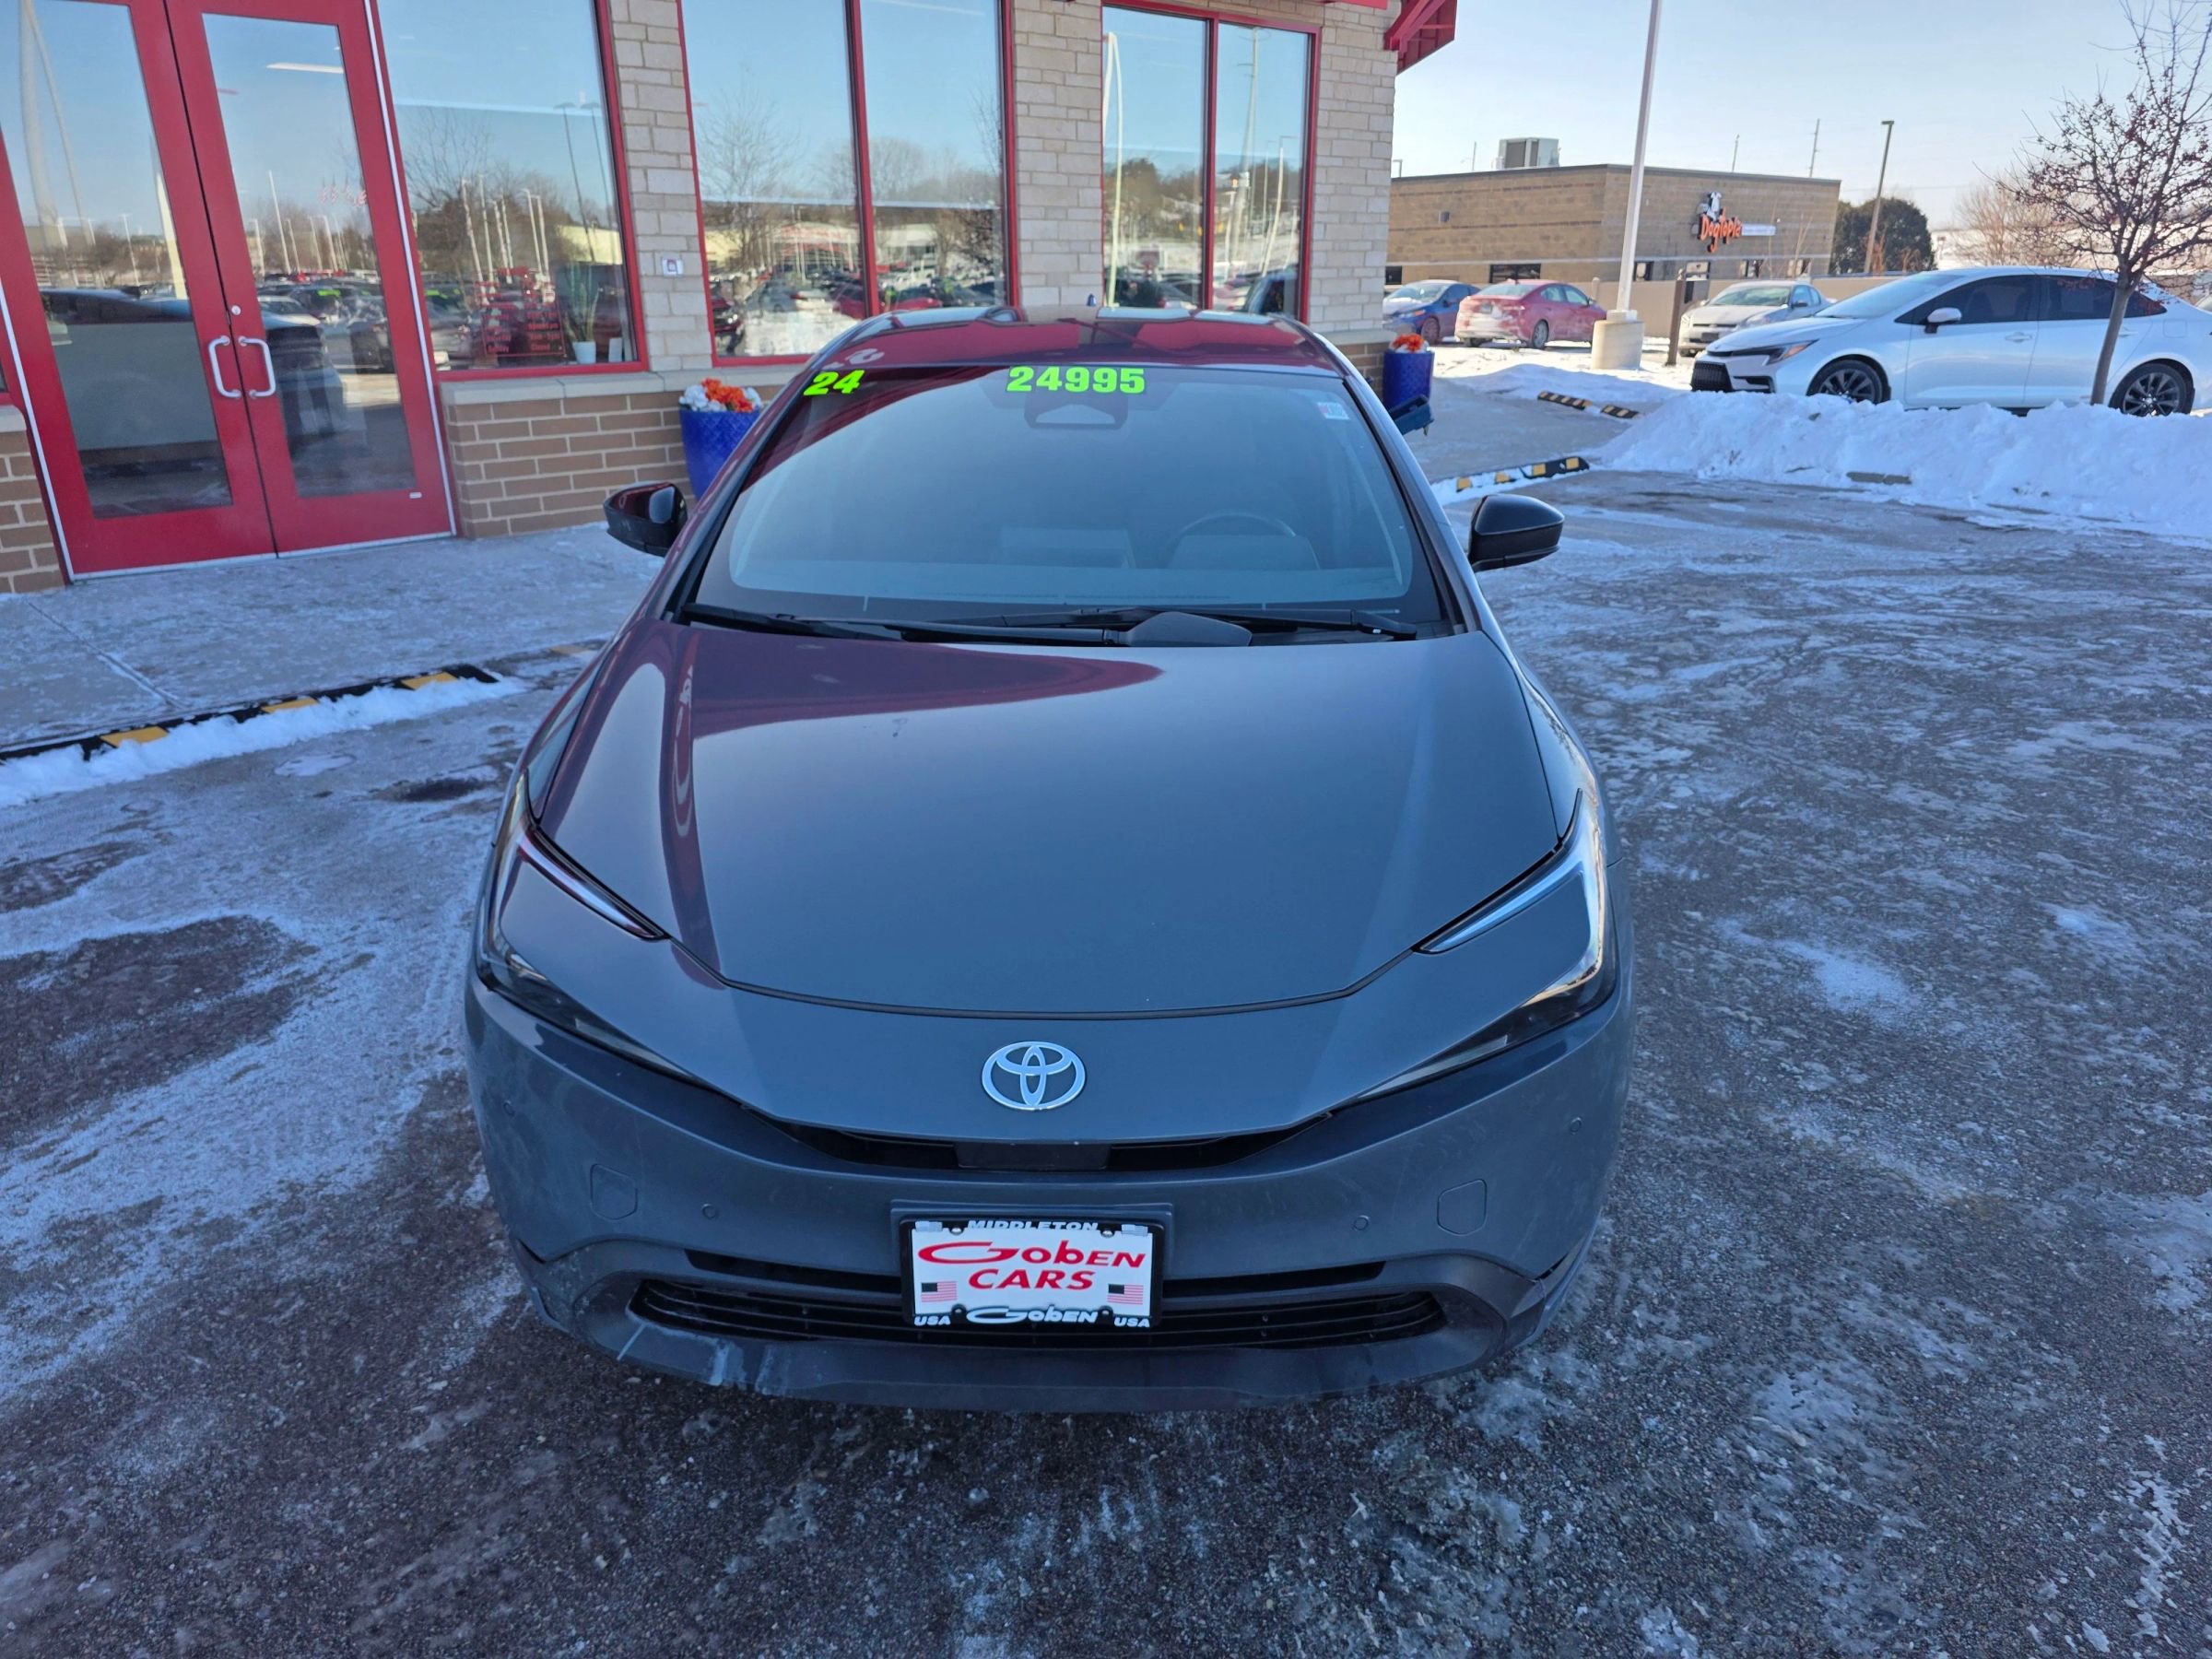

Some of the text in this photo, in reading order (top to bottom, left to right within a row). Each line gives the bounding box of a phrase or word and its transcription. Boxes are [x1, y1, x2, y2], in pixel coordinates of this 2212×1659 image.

[804, 370, 865, 396] 24
[1006, 365, 1146, 394] 24995
[967, 1219, 1099, 1230] MIDDLETON
[968, 1268, 1095, 1290] CARS
[914, 1315, 951, 1326] USA
[1113, 1317, 1150, 1328] USA
